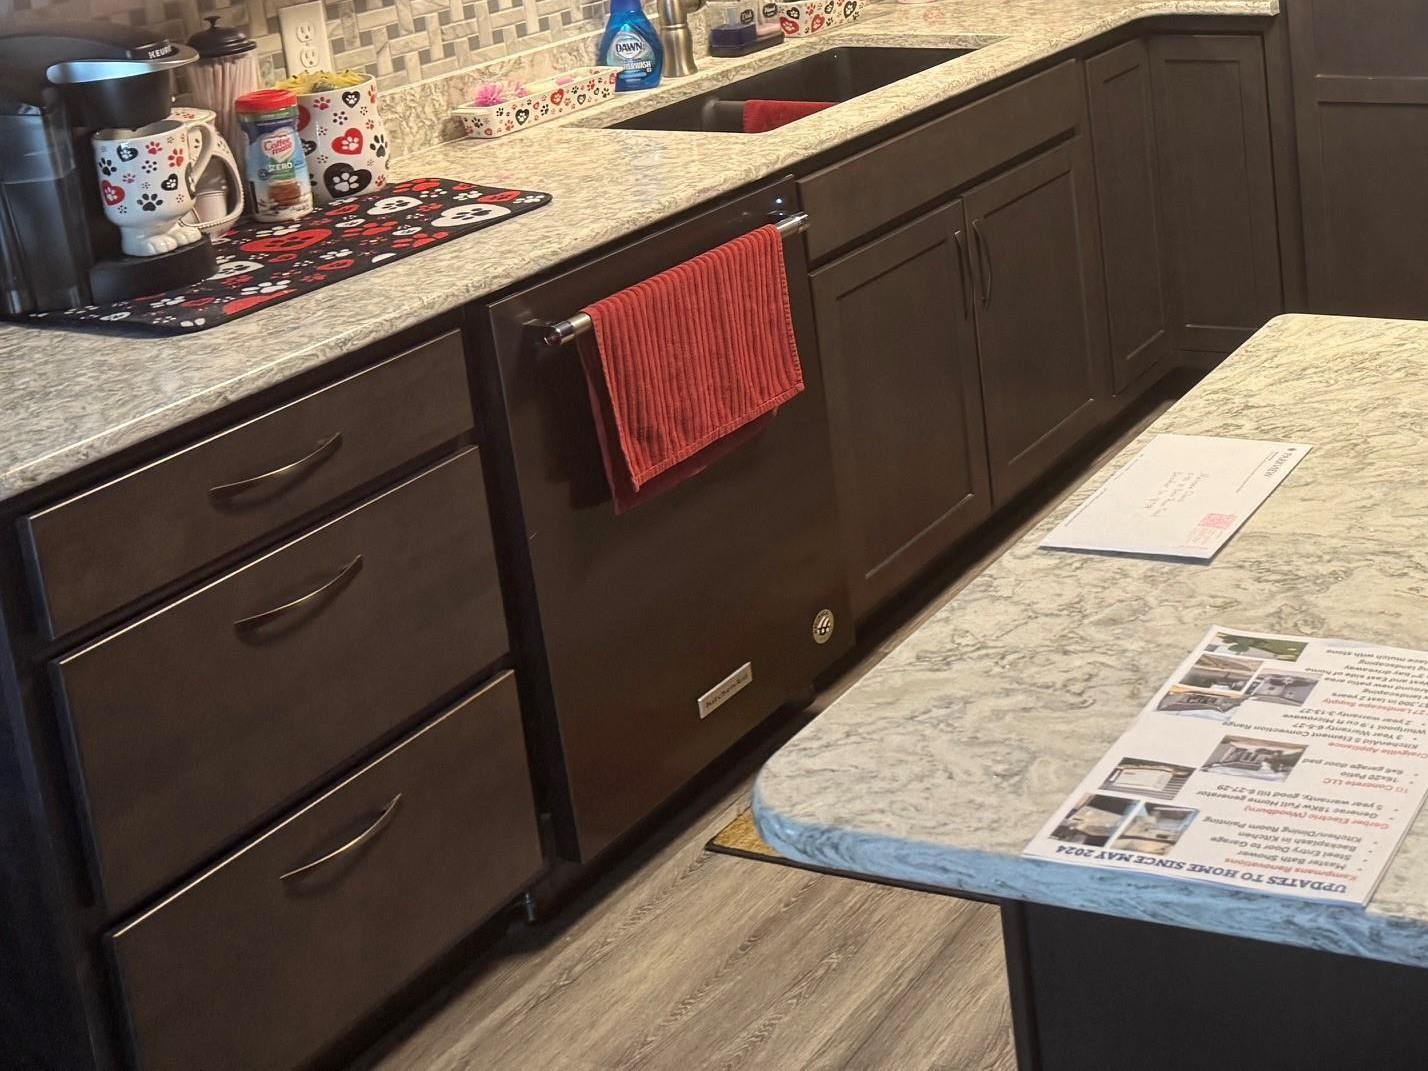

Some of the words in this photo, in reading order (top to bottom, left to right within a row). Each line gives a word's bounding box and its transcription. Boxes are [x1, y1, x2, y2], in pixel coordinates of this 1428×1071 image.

[615, 42, 643, 53] DAWN
[268, 161, 293, 173] ZERO
[1196, 791, 1247, 801] generator
[1056, 845, 1094, 857] 2024
[1095, 851, 1133, 862] MAY
[1134, 856, 1185, 869] SINCE
[1187, 864, 1238, 878] HOME
[1241, 872, 1263, 883] TO
[1267, 876, 1346, 893] UPDATES
